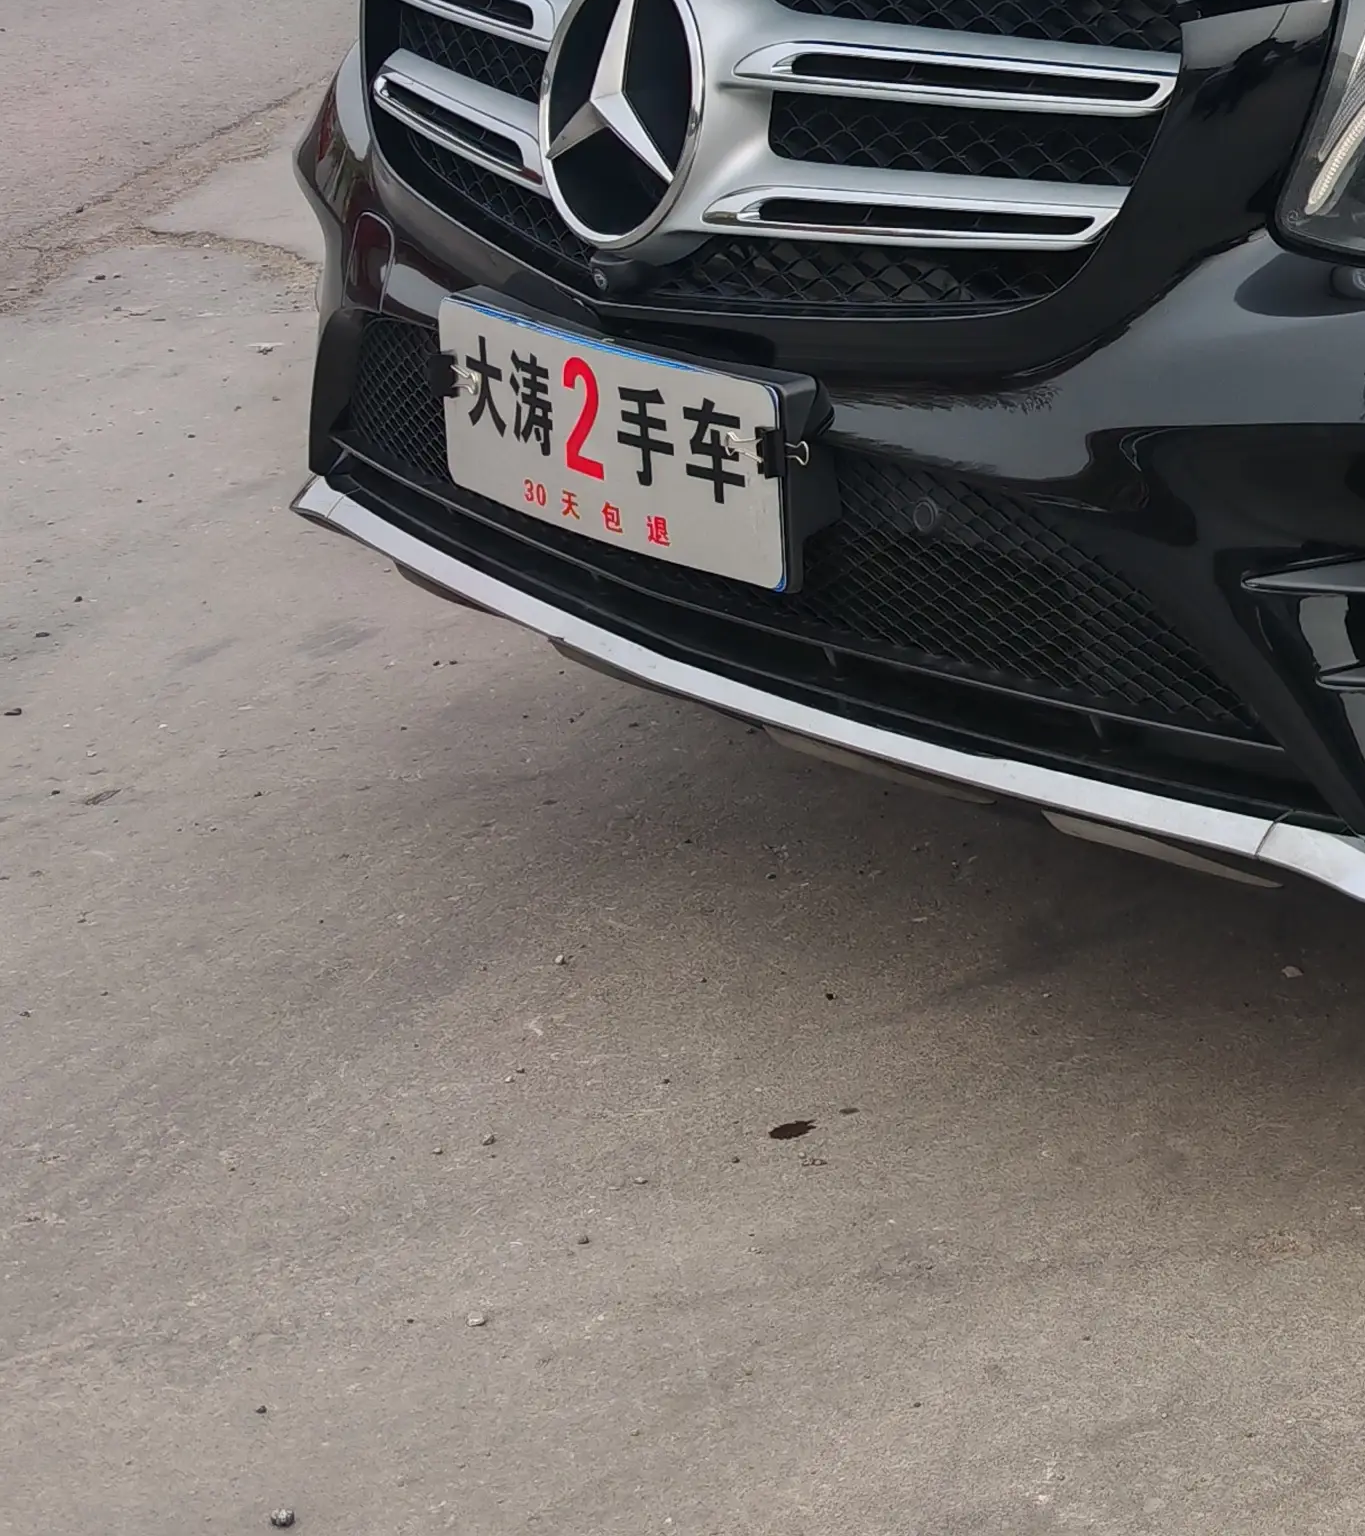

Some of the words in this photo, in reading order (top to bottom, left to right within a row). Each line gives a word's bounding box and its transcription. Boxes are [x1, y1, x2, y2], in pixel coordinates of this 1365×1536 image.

[464, 335, 746, 505] 大涛2手车
[523, 478, 671, 548] 30天包退
